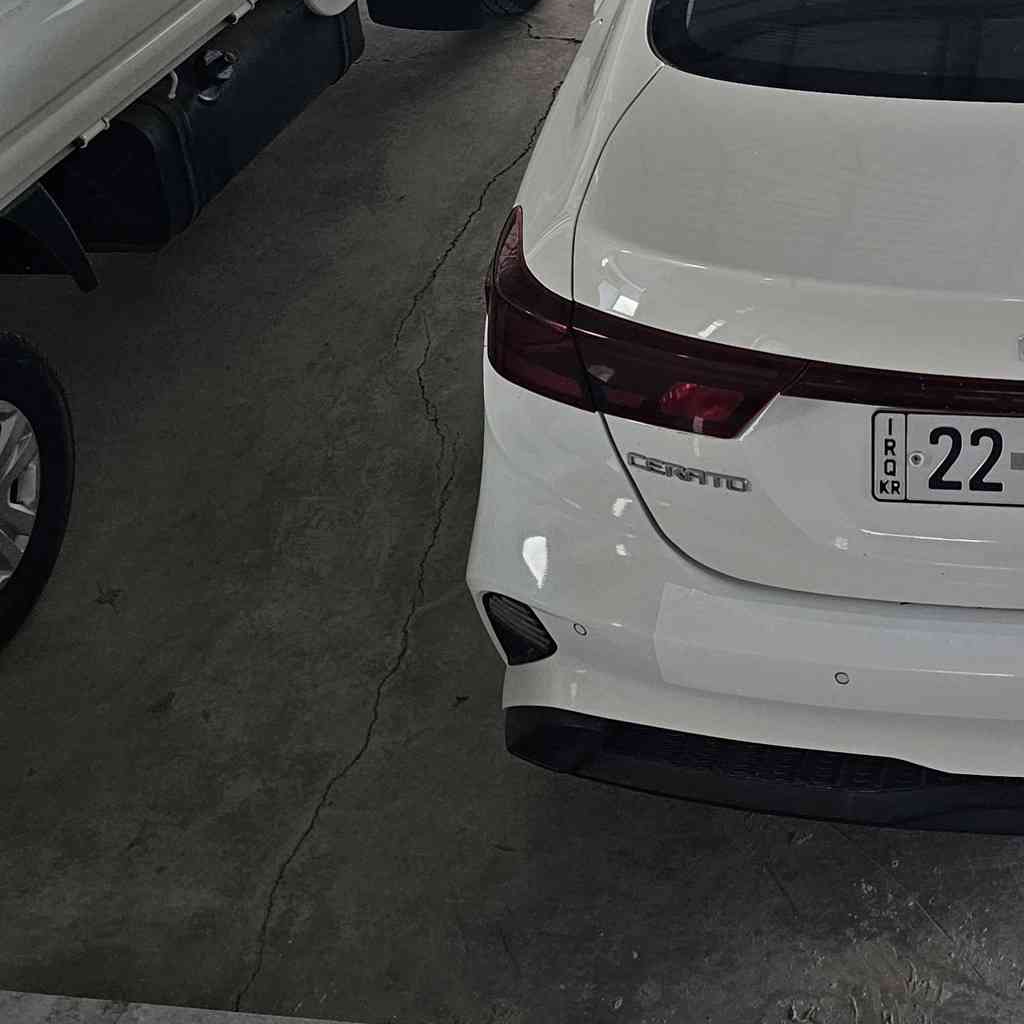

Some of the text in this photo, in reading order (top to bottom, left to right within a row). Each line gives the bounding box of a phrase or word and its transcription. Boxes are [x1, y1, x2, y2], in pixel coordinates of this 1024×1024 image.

[627, 451, 752, 493] CERATO
[927, 426, 1004, 492] 22
[880, 479, 901, 495] KR
